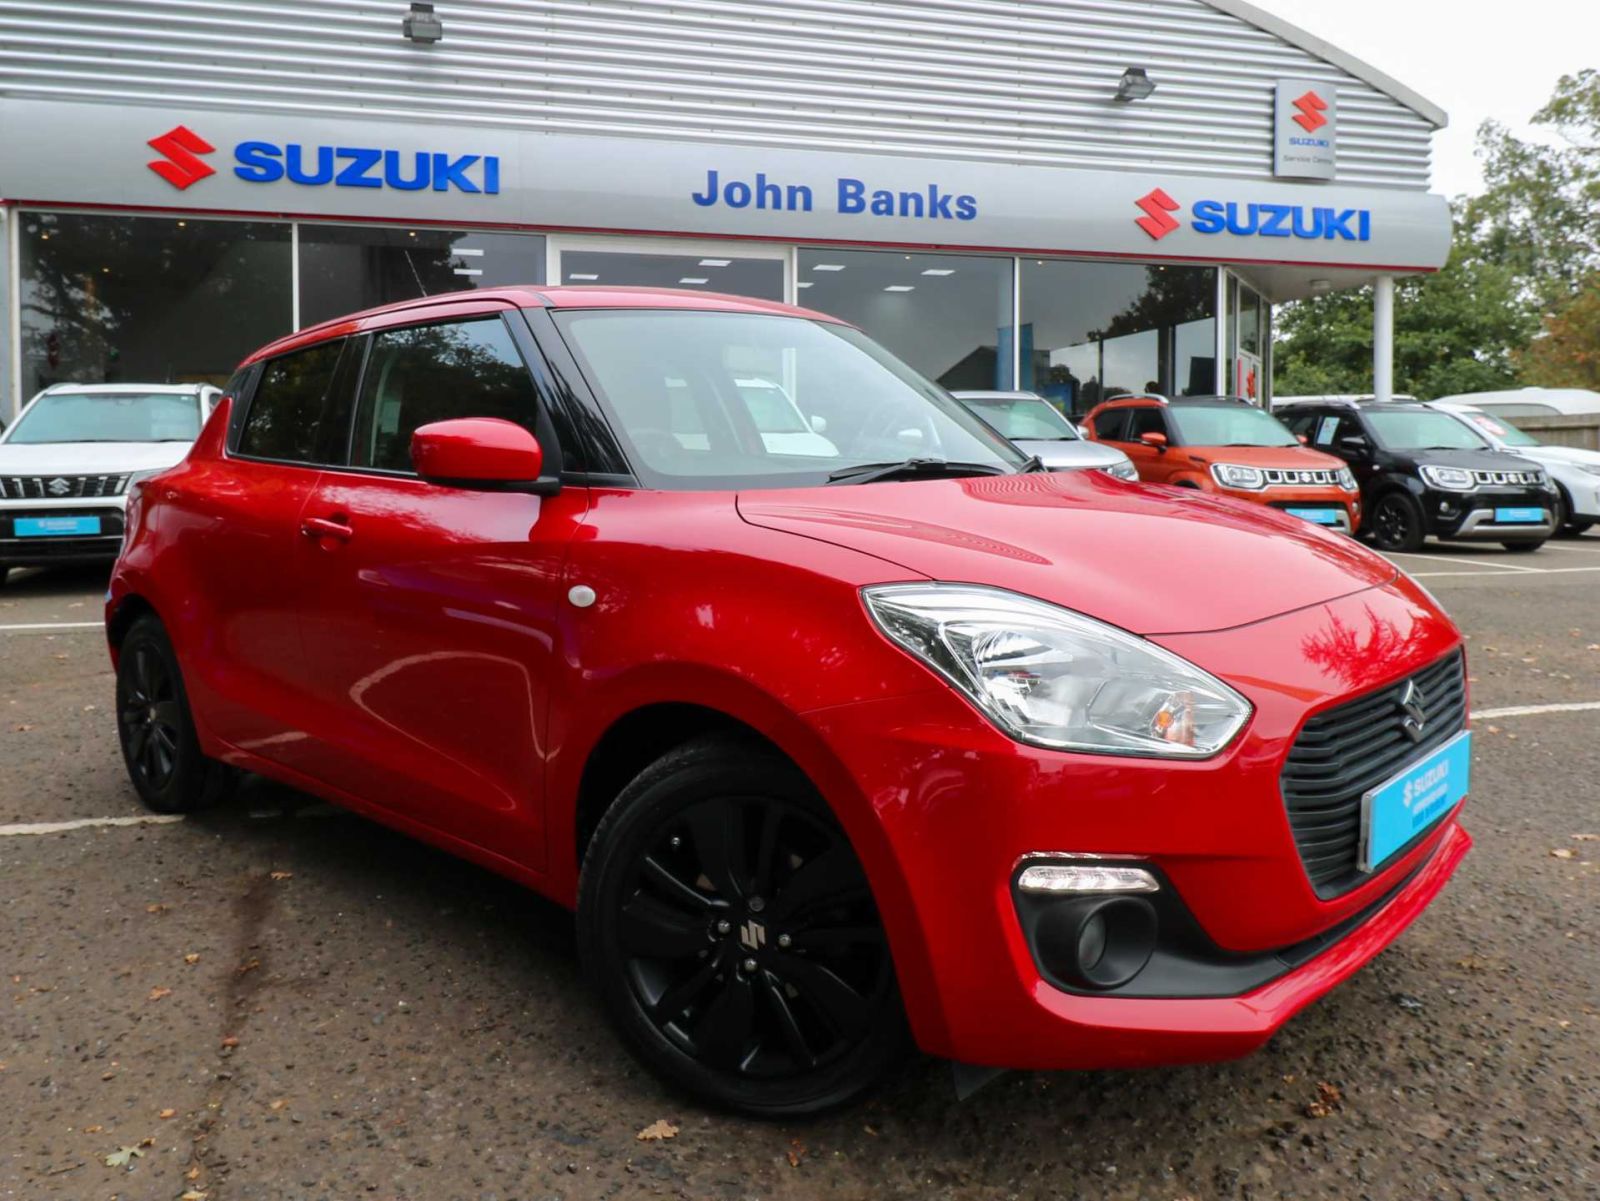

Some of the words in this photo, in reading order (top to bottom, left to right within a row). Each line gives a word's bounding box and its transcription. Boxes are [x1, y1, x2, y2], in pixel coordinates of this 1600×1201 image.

[1289, 137, 1329, 148] SUZUKI
[233, 141, 499, 194] SUZUKI
[692, 170, 812, 211] John
[837, 178, 977, 221] Banks
[1191, 200, 1370, 241] SUZUKI
